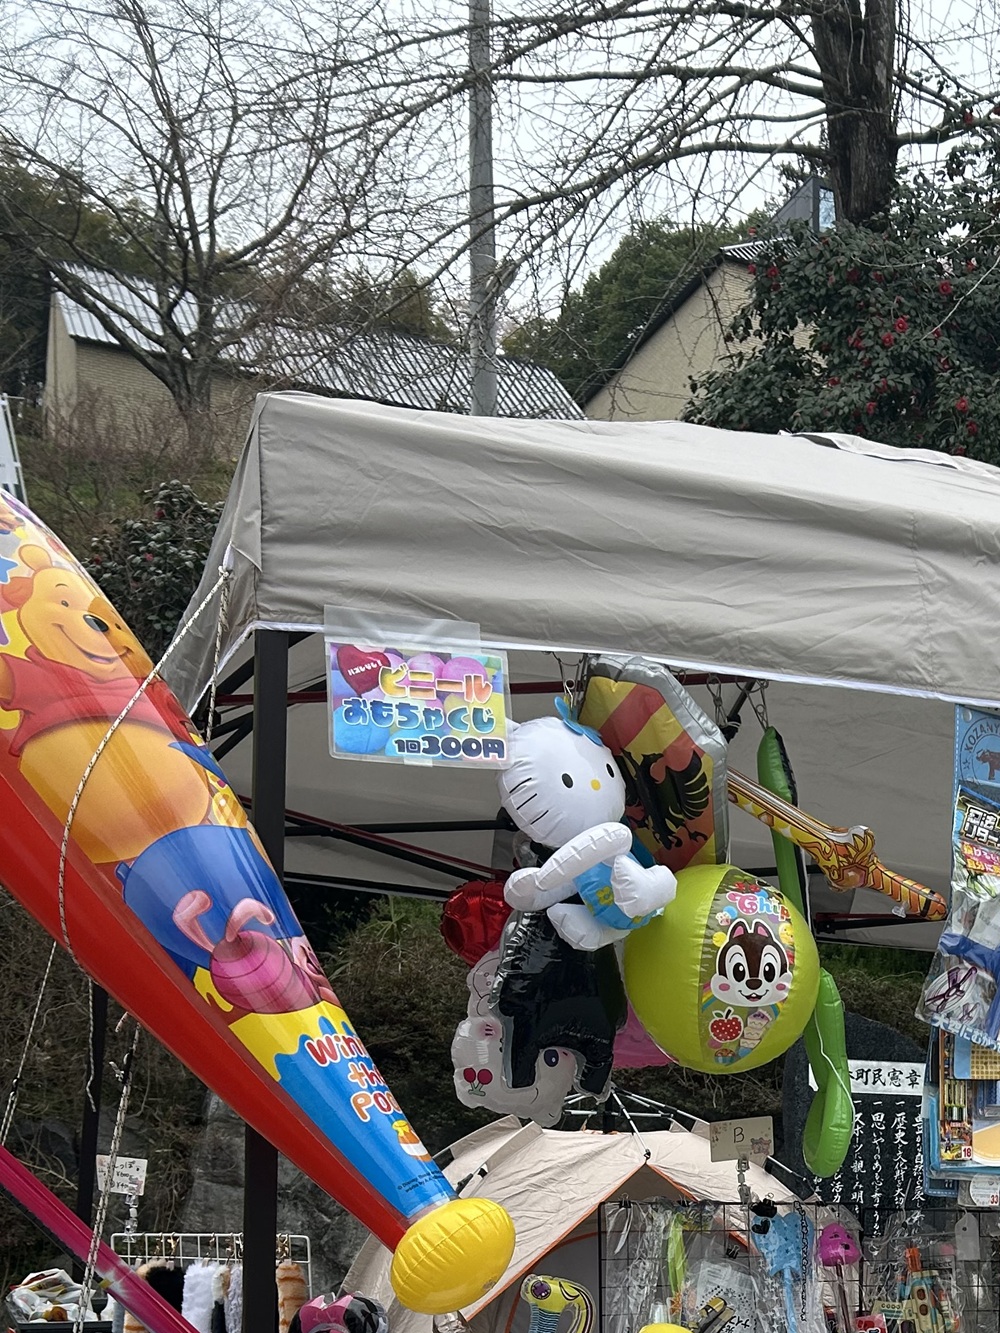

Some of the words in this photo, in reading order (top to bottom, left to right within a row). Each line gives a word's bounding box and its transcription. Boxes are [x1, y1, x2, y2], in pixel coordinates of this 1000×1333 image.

[379, 663, 492, 704] ビニール
[341, 697, 496, 733] おもちゃくじ
[394, 735, 507, 760] 1回300円
[733, 1126, 745, 1144] B
[962, 1147, 972, 1157] 18
[990, 1195, 999, 1204] 33
